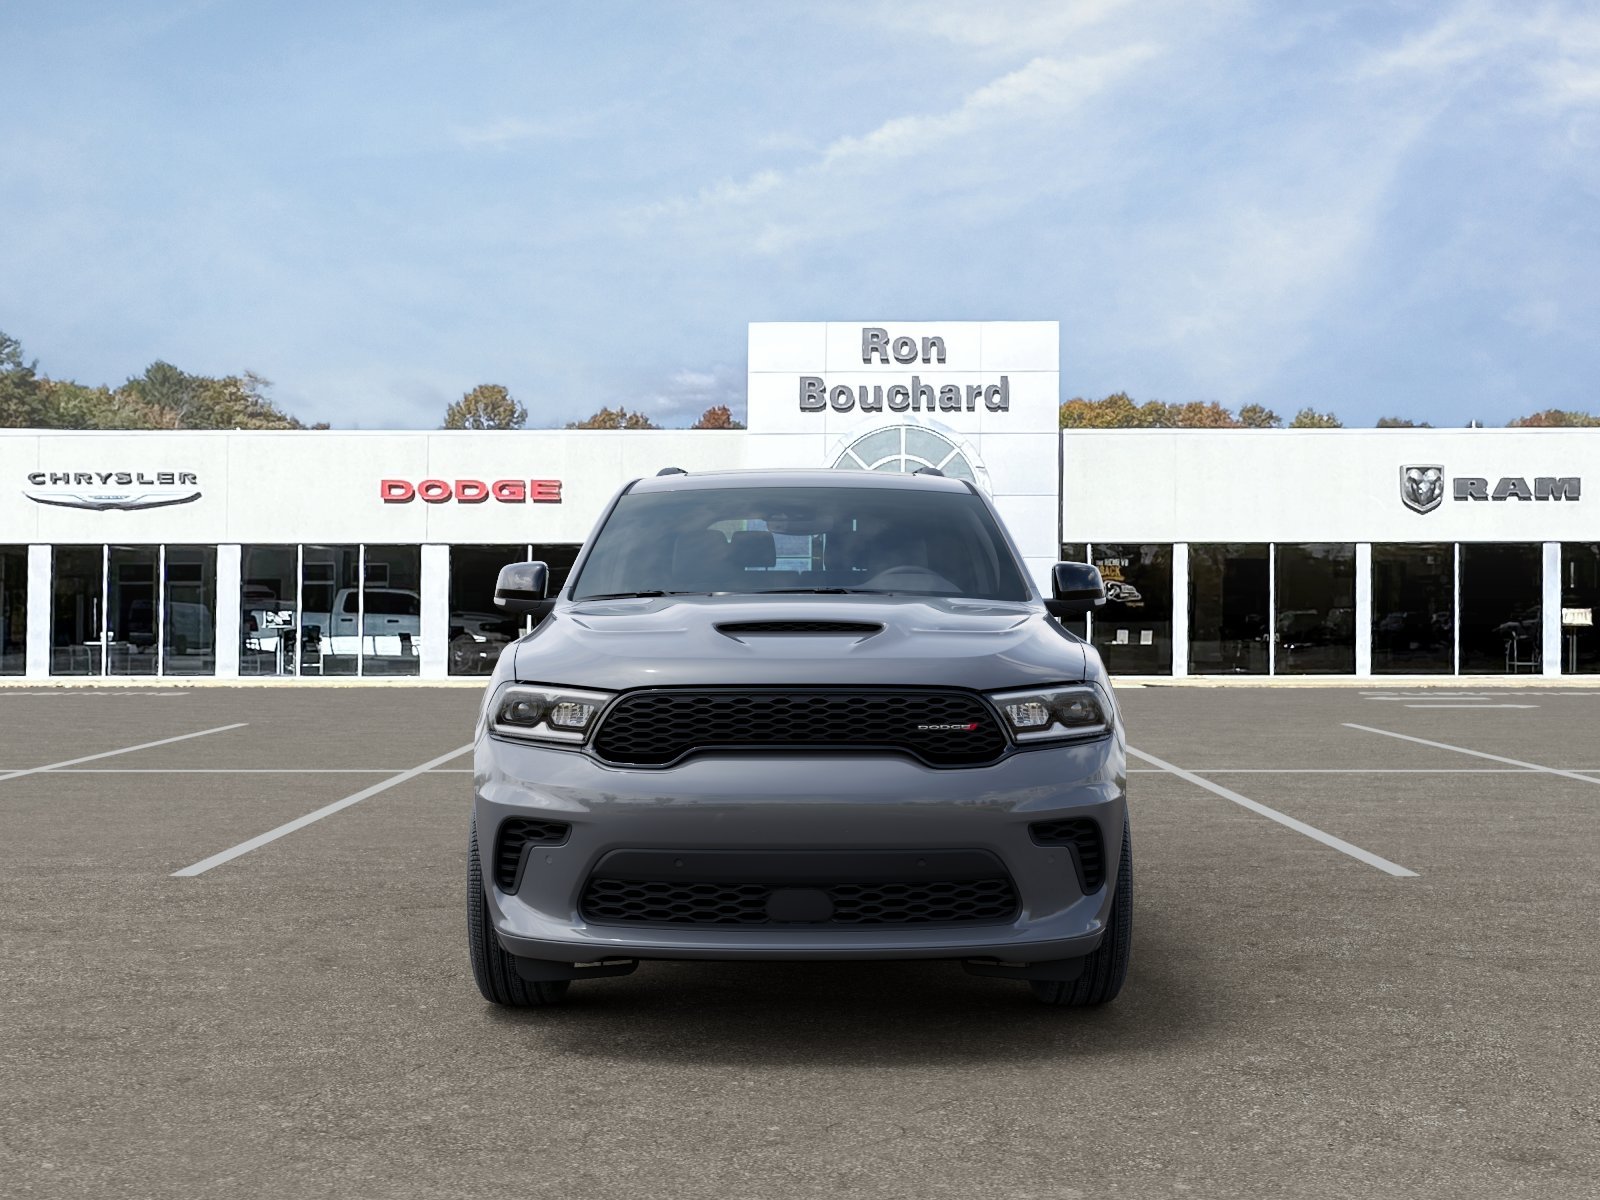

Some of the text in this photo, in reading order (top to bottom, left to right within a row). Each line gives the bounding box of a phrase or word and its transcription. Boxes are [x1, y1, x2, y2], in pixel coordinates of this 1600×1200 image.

[862, 328, 946, 364] Ron
[799, 376, 1009, 412] Bouchard
[27, 472, 198, 485] CHRYSLER
[1453, 477, 1581, 501] RAM
[381, 479, 562, 503] DODGE
